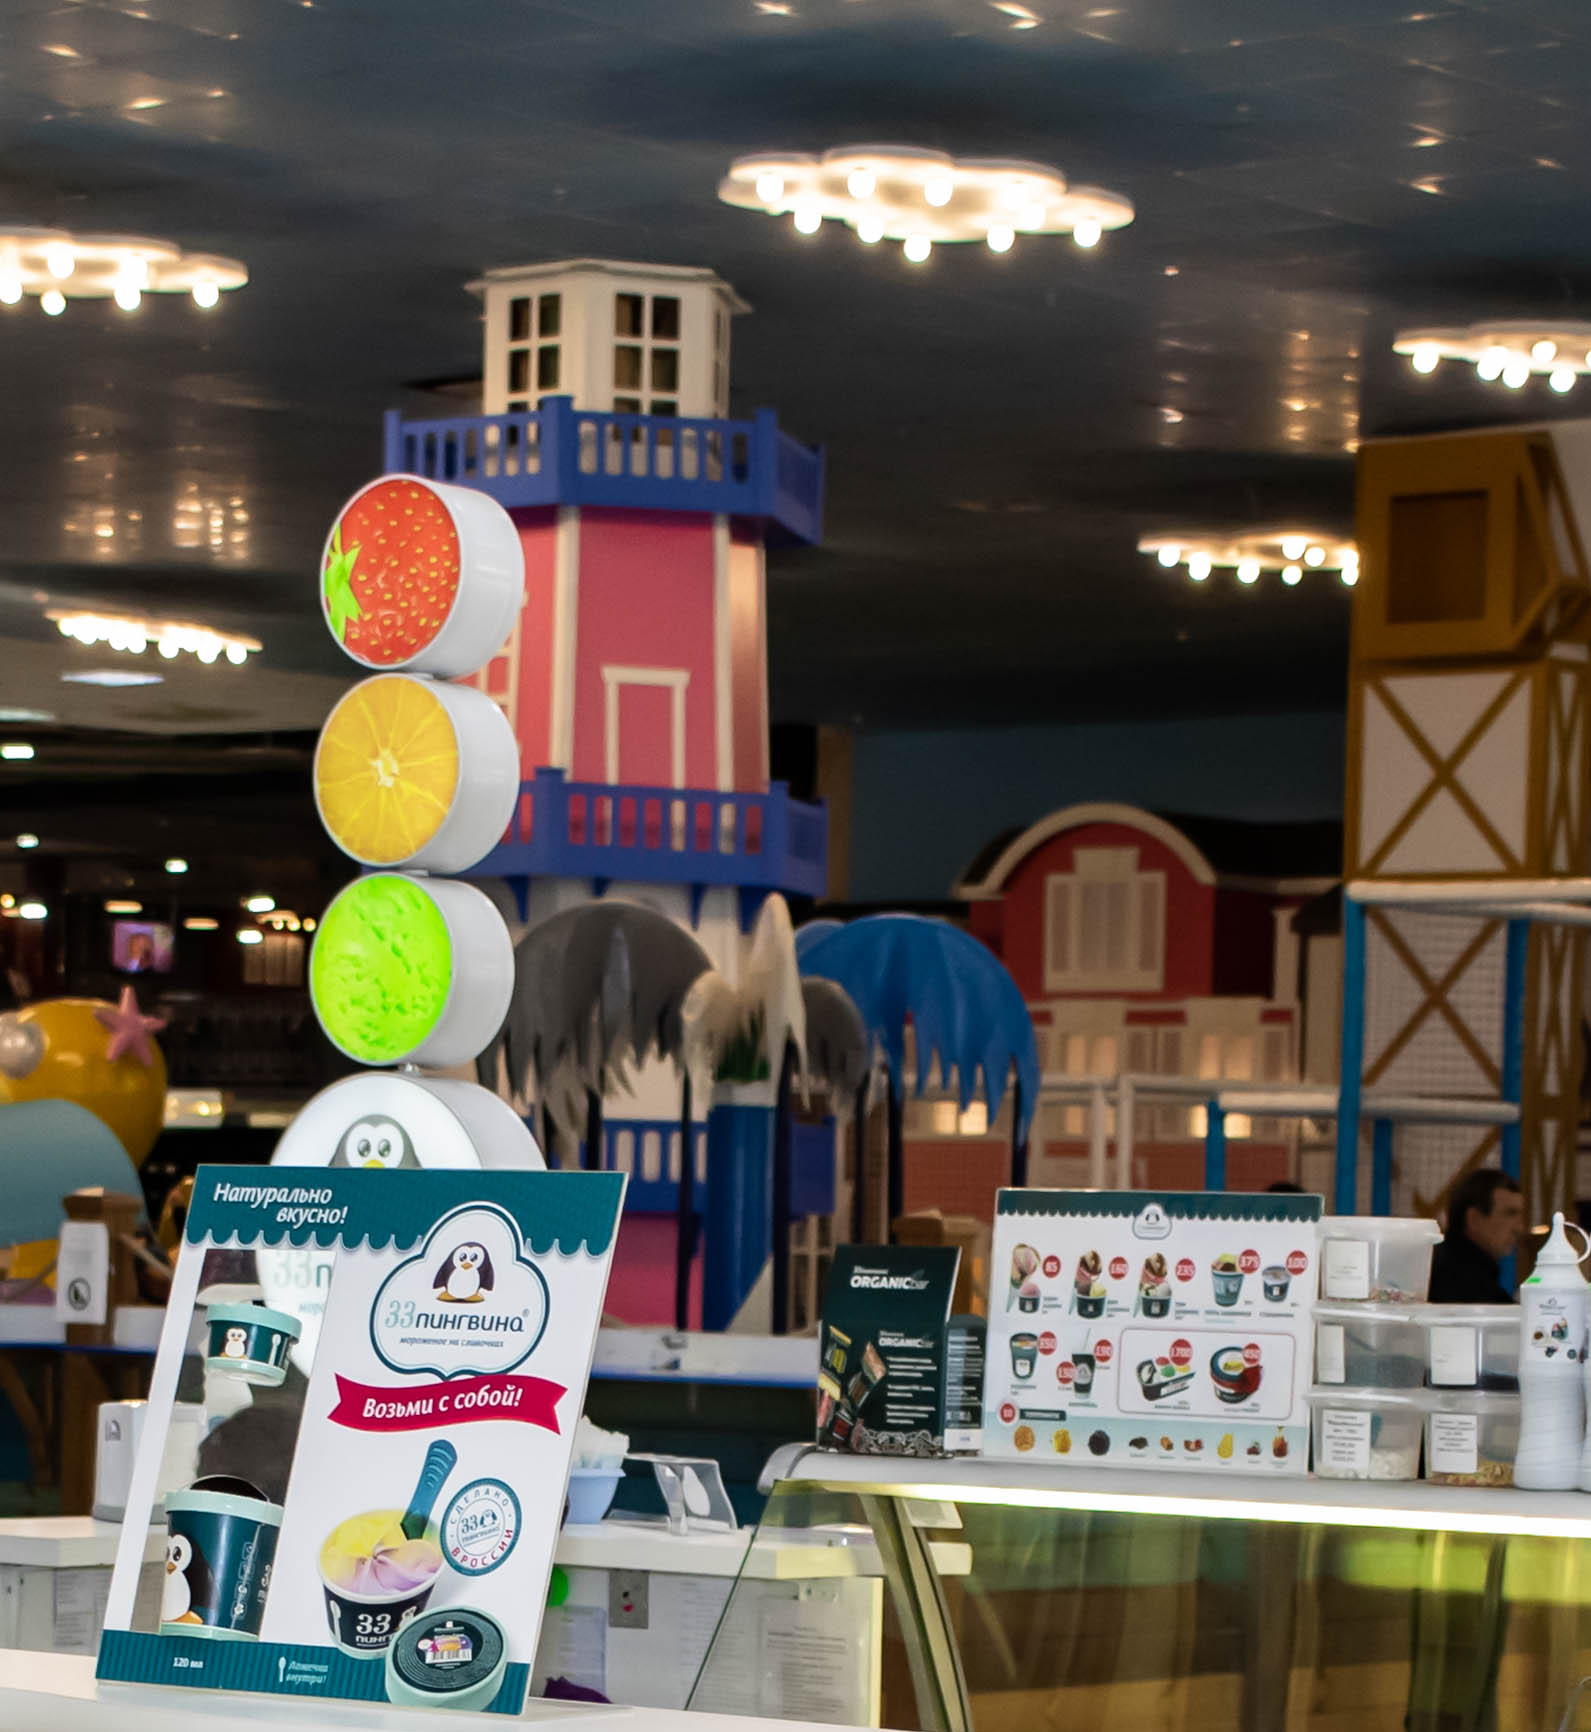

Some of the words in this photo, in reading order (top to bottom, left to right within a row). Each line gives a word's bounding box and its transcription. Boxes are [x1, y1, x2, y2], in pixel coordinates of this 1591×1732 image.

[213, 1182, 333, 1209] Натурально
[276, 1206, 349, 1228] вкусно!
[362, 1398, 433, 1419] Возьми
[438, 1396, 449, 1411] с
[454, 1387, 524, 1410] собой!
[450, 1488, 510, 1525] СДЕЛАНО
[460, 1529, 513, 1568] РОССИИ
[356, 1613, 392, 1634] 33
